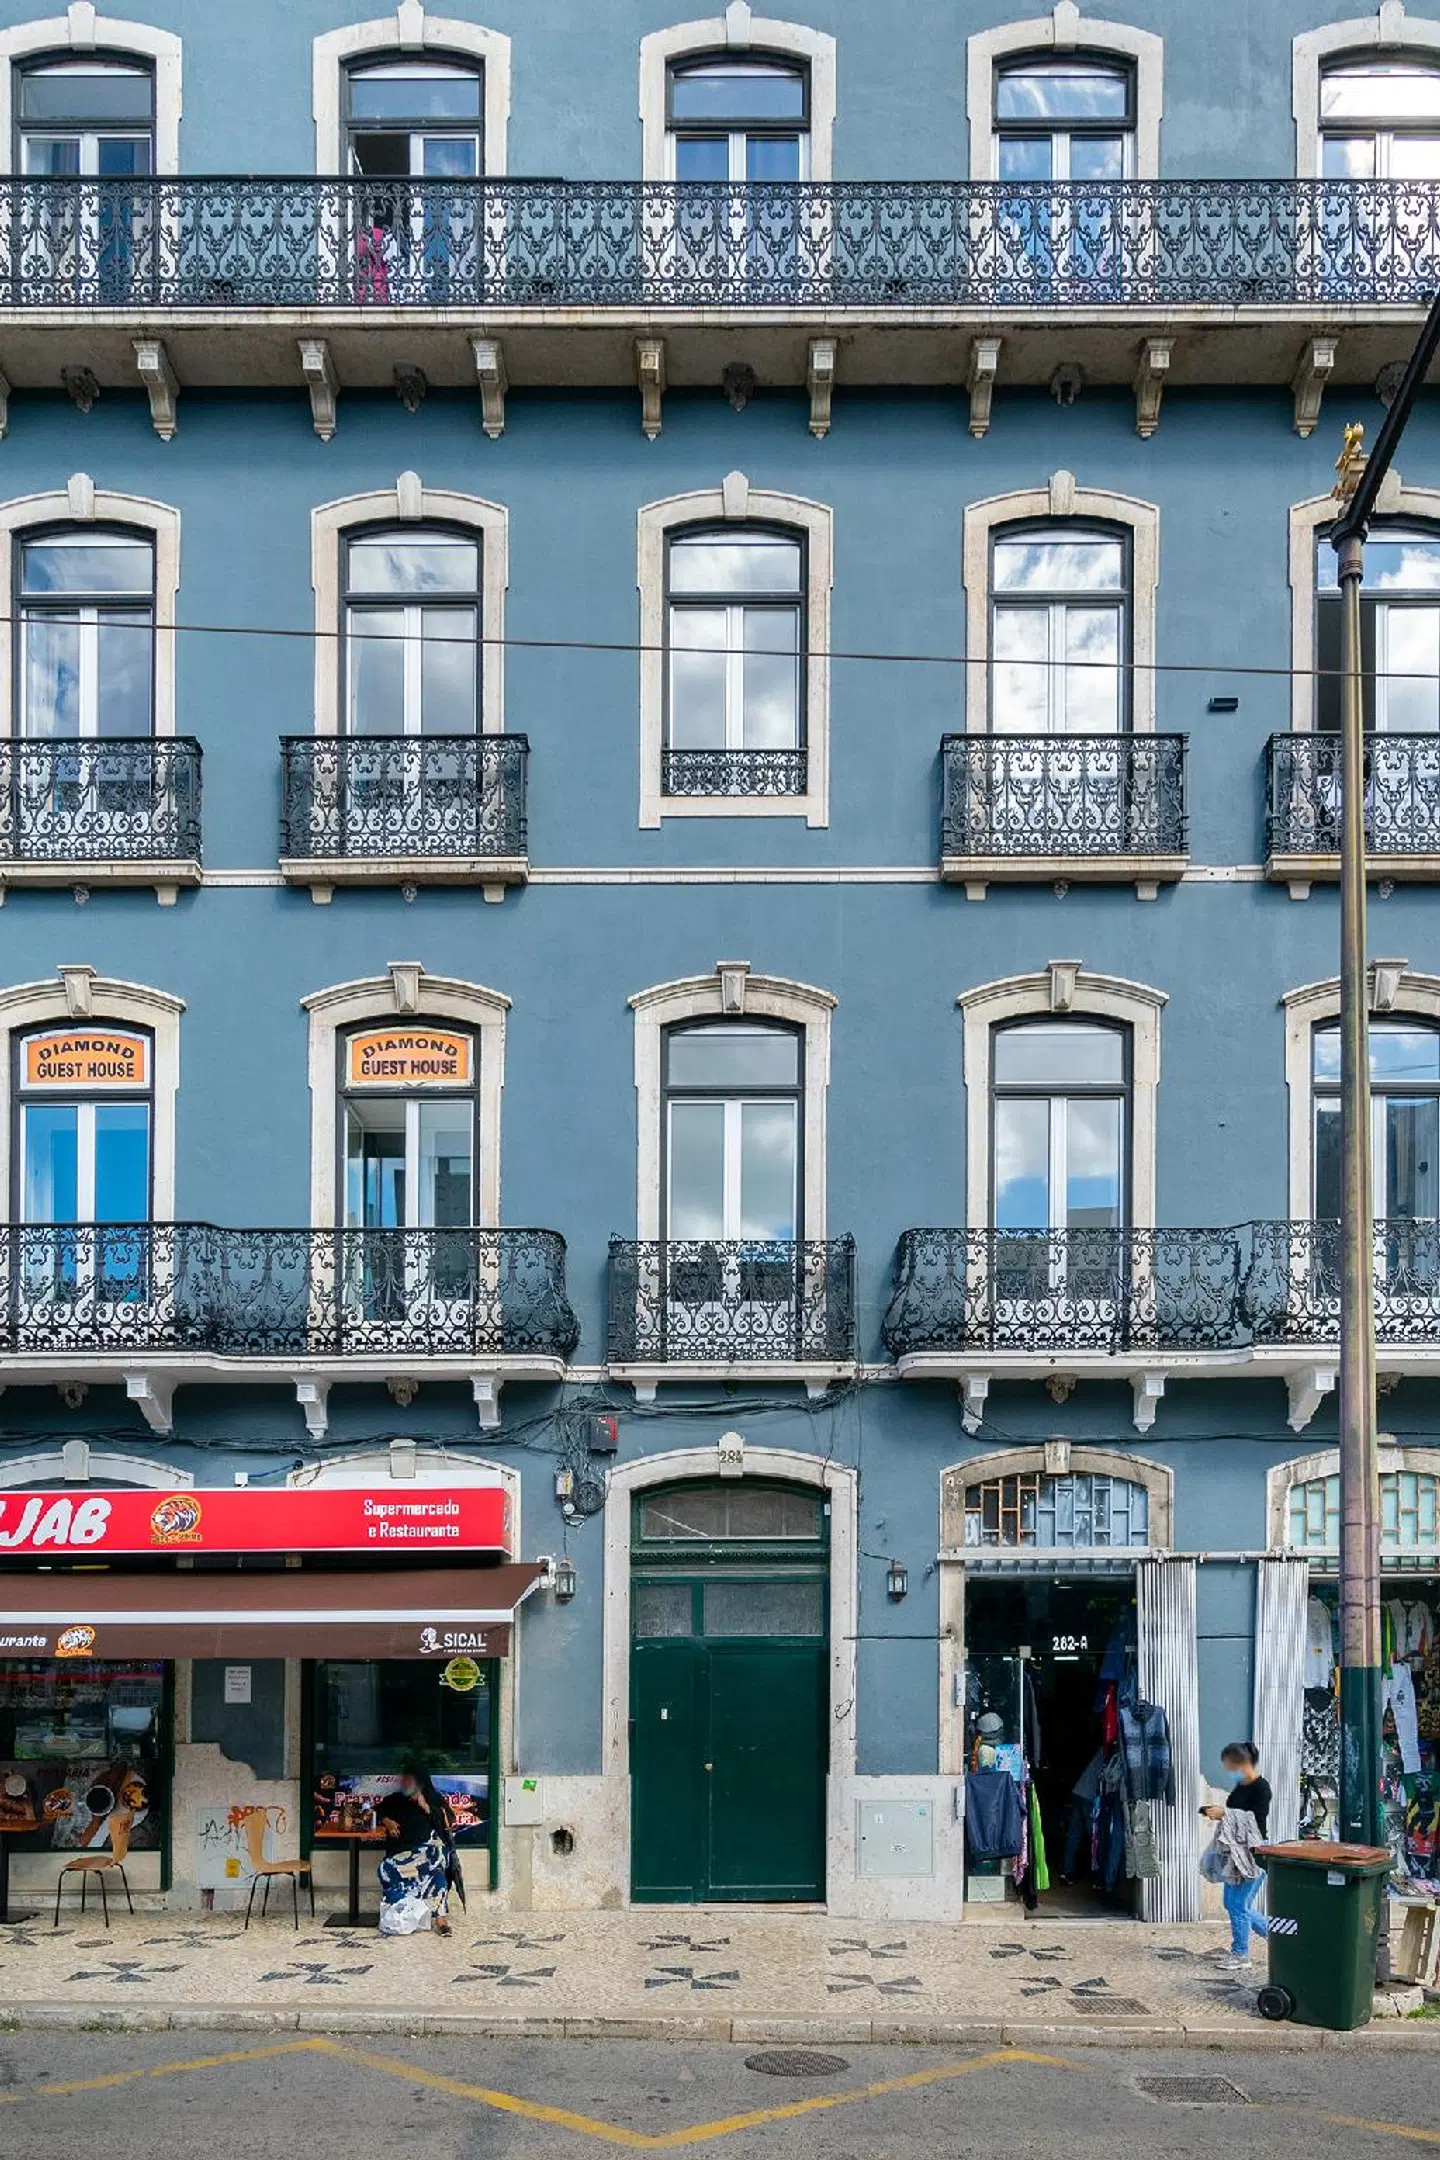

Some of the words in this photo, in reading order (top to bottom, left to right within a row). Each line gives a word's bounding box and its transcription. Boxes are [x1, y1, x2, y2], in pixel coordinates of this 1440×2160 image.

[39, 1041, 136, 1060] DIAMOND
[363, 1038, 458, 1058] DIAMOND
[37, 1062, 82, 1077] GUEST
[87, 1062, 135, 1077] HOUSE
[361, 1060, 406, 1075] GUEST
[411, 1060, 457, 1075] HOUSE
[719, 1450, 743, 1463] 284
[363, 1499, 460, 1518] Supermercado
[0, 1497, 112, 1546] JAB
[369, 1527, 377, 1538] e
[380, 1522, 460, 1538] Restaurante
[0, 1635, 47, 1647] urante
[444, 1633, 487, 1647] SICAL
[1053, 1635, 1088, 1650] 282-A
